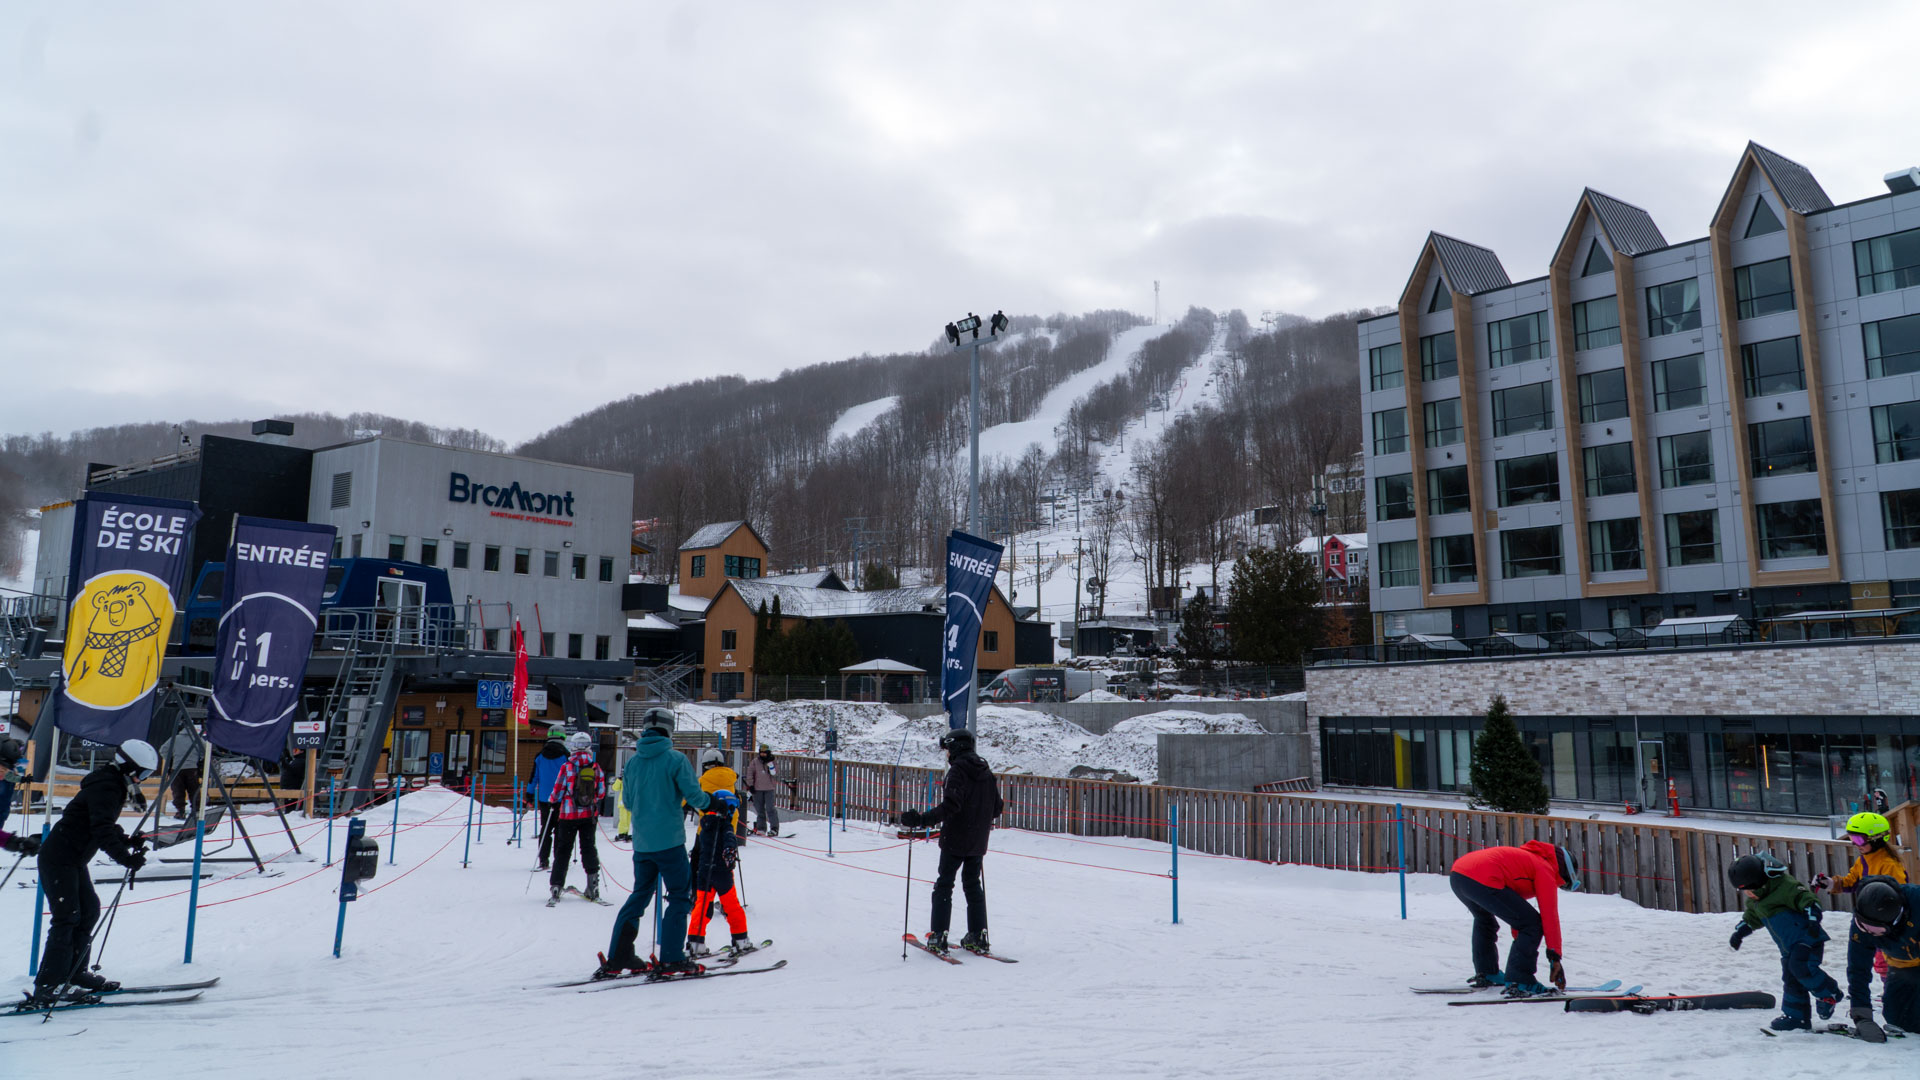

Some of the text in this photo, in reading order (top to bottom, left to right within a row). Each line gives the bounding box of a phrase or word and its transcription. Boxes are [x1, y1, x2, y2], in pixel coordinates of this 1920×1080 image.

[101, 506, 187, 535] ÉCOLE
[97, 530, 181, 556] DE SKI
[237, 542, 327, 569] ENTRÉE
[949, 551, 995, 578] ENTRÉE
[256, 631, 272, 667] 1
[947, 624, 959, 652] 4
[297, 736, 320, 745] 01-02
